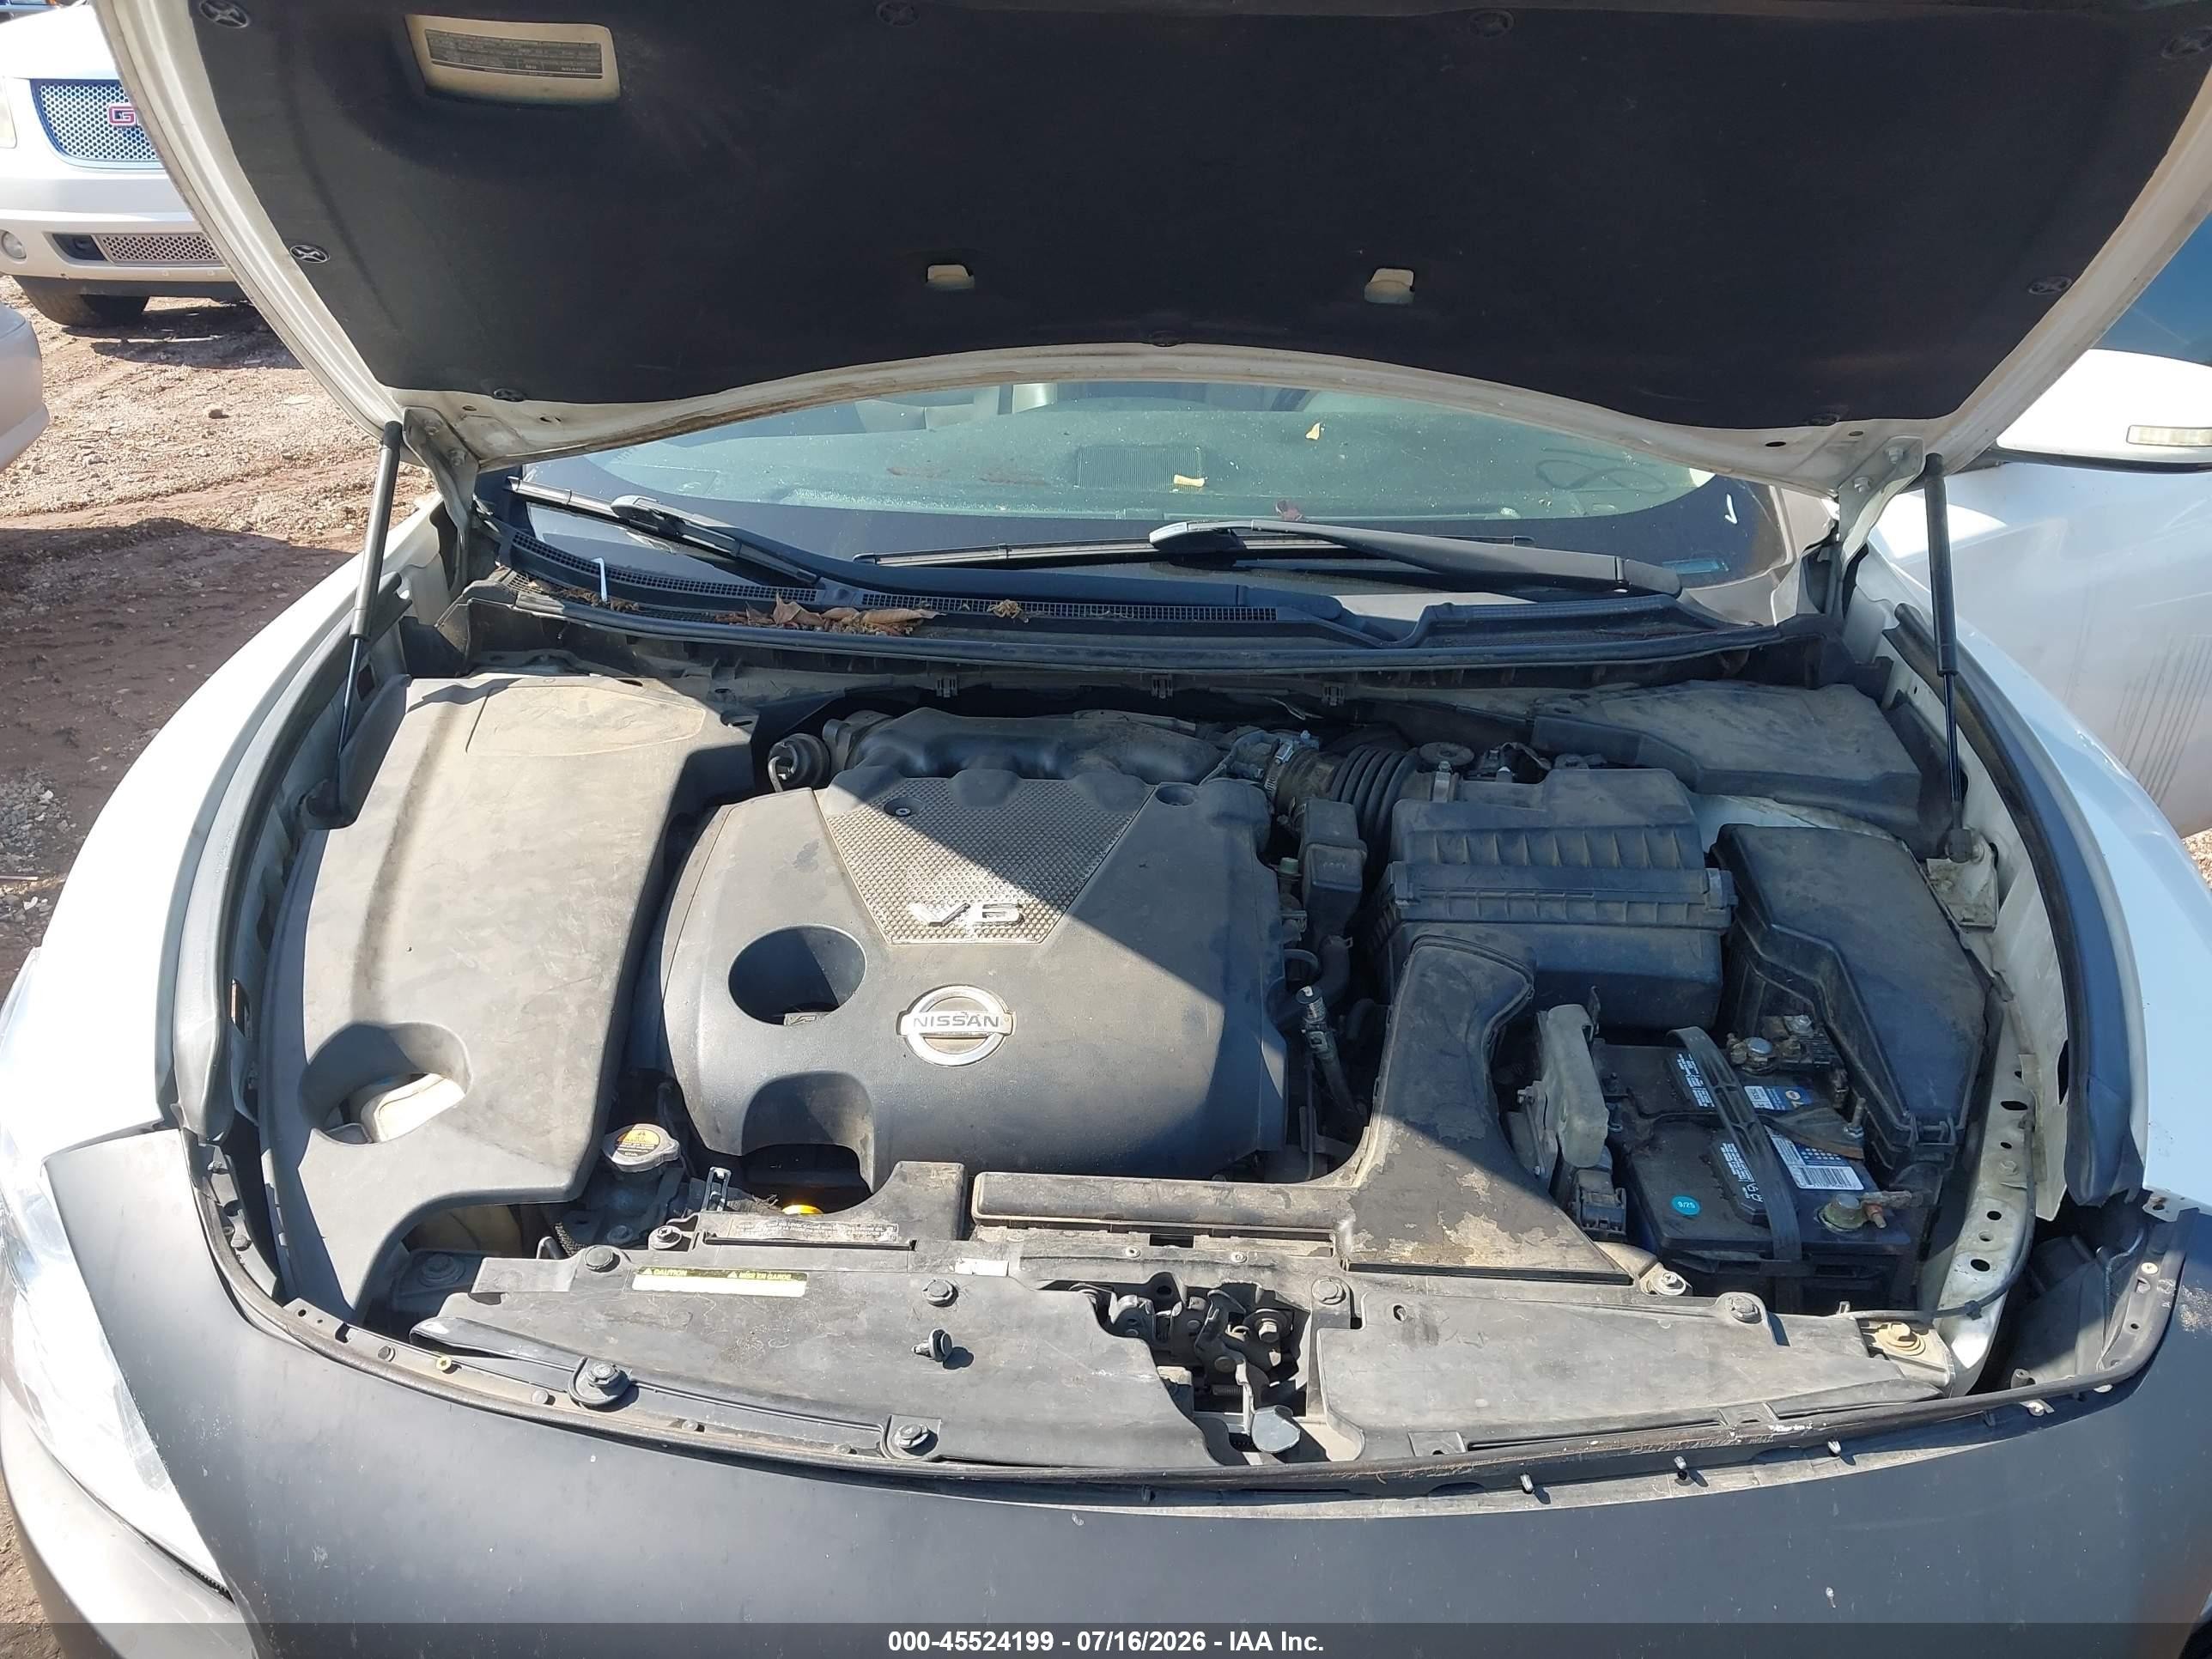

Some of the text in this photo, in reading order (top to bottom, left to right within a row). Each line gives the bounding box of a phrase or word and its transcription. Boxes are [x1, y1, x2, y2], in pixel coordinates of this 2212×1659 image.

[108, 104, 137, 125] G
[907, 902, 1025, 928] V6
[913, 1015, 1000, 1028] NISSAN
